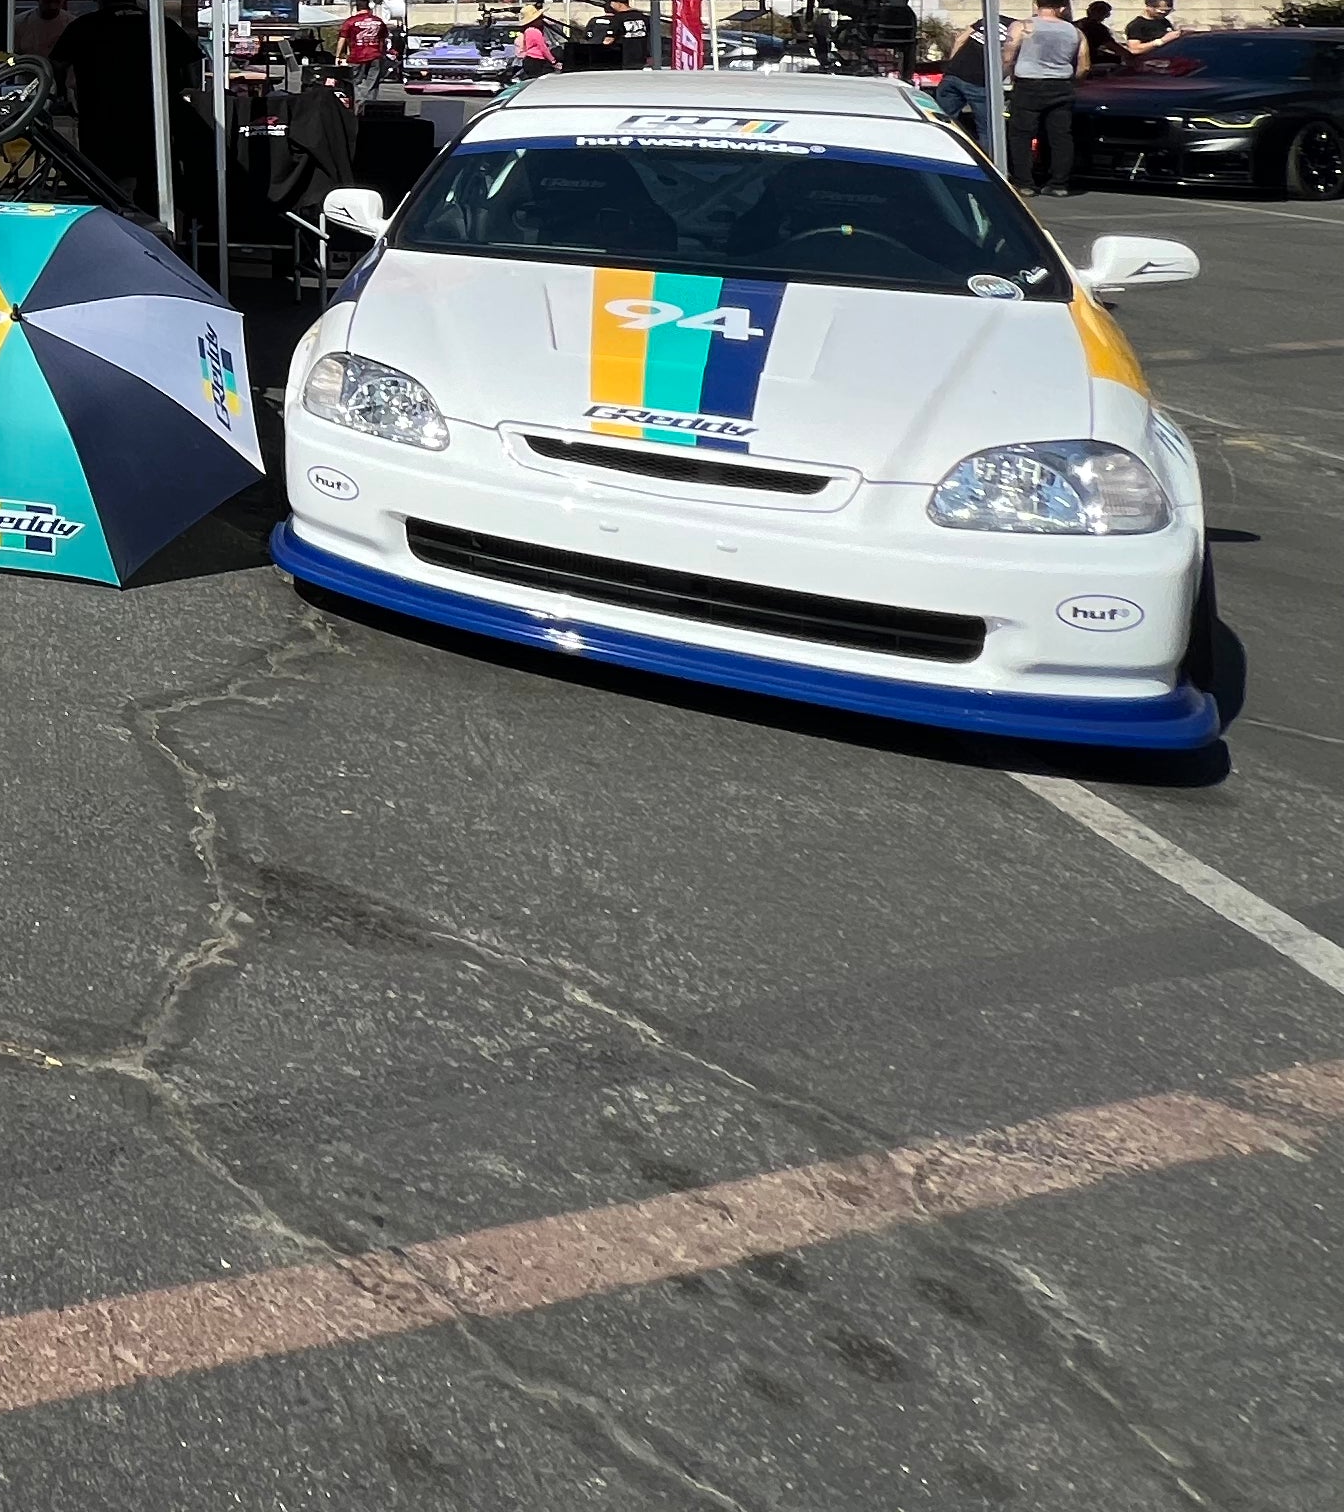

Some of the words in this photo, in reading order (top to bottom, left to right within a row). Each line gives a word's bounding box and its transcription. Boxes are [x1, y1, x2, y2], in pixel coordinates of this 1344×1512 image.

[575, 136, 634, 147] huf
[604, 298, 764, 341] 94
[582, 405, 759, 436] GReddy
